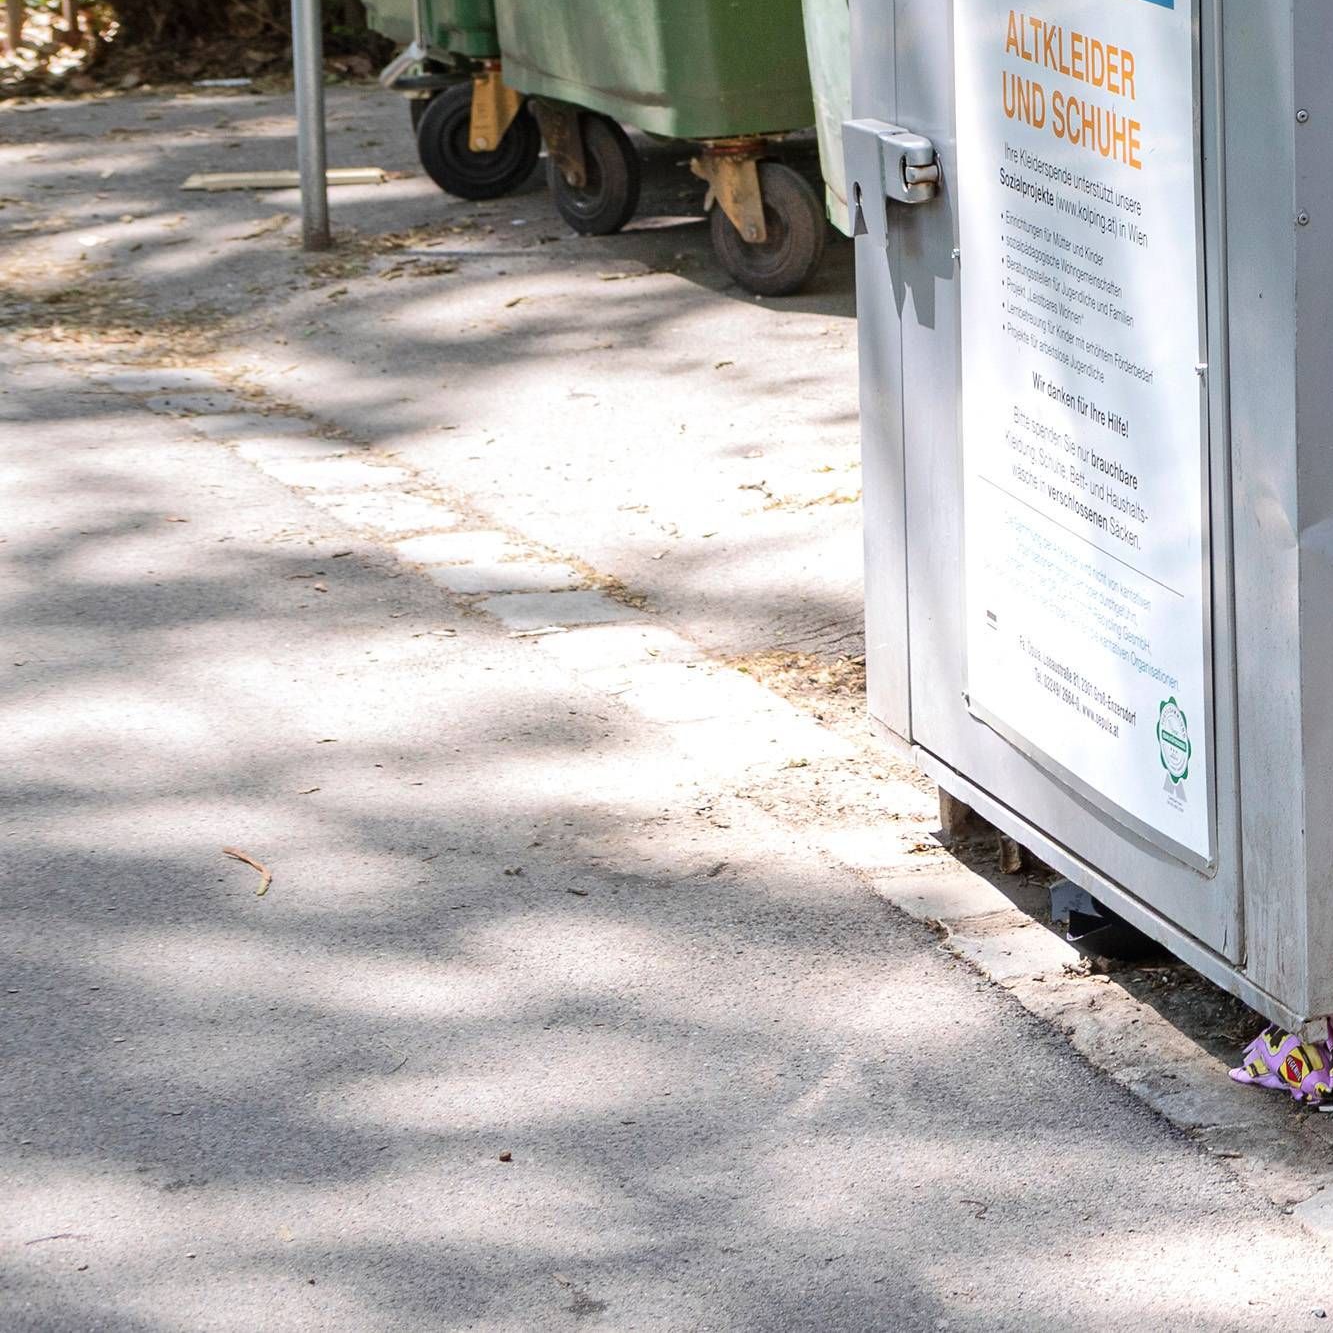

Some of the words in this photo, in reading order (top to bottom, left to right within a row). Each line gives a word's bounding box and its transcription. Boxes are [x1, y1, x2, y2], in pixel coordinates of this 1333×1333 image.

[1005, 10, 1135, 100] ALTKLEIDER
[1002, 69, 1044, 131] UND
[1051, 87, 1141, 170] SCHUHE
[999, 166, 1053, 210] Sozialprojekte
[1118, 217, 1125, 238] in
[1128, 222, 1148, 249] Wien
[1004, 142, 1017, 164] Ihre
[1020, 148, 1071, 189] Kleiderspende
[1073, 171, 1113, 205] unterstützt
[1116, 192, 1142, 217] unsere
[1032, 370, 1045, 394] Wir
[1047, 379, 1075, 410] danken
[1077, 394, 1088, 418] für
[1090, 401, 1105, 427] Ihre
[1107, 409, 1128, 439] Hilfe!
[1089, 476, 1104, 502] und
[1106, 485, 1148, 527] Haushalts-
[1091, 448, 1137, 491] brauchbare
[1047, 480, 1107, 532] verschlossenen
